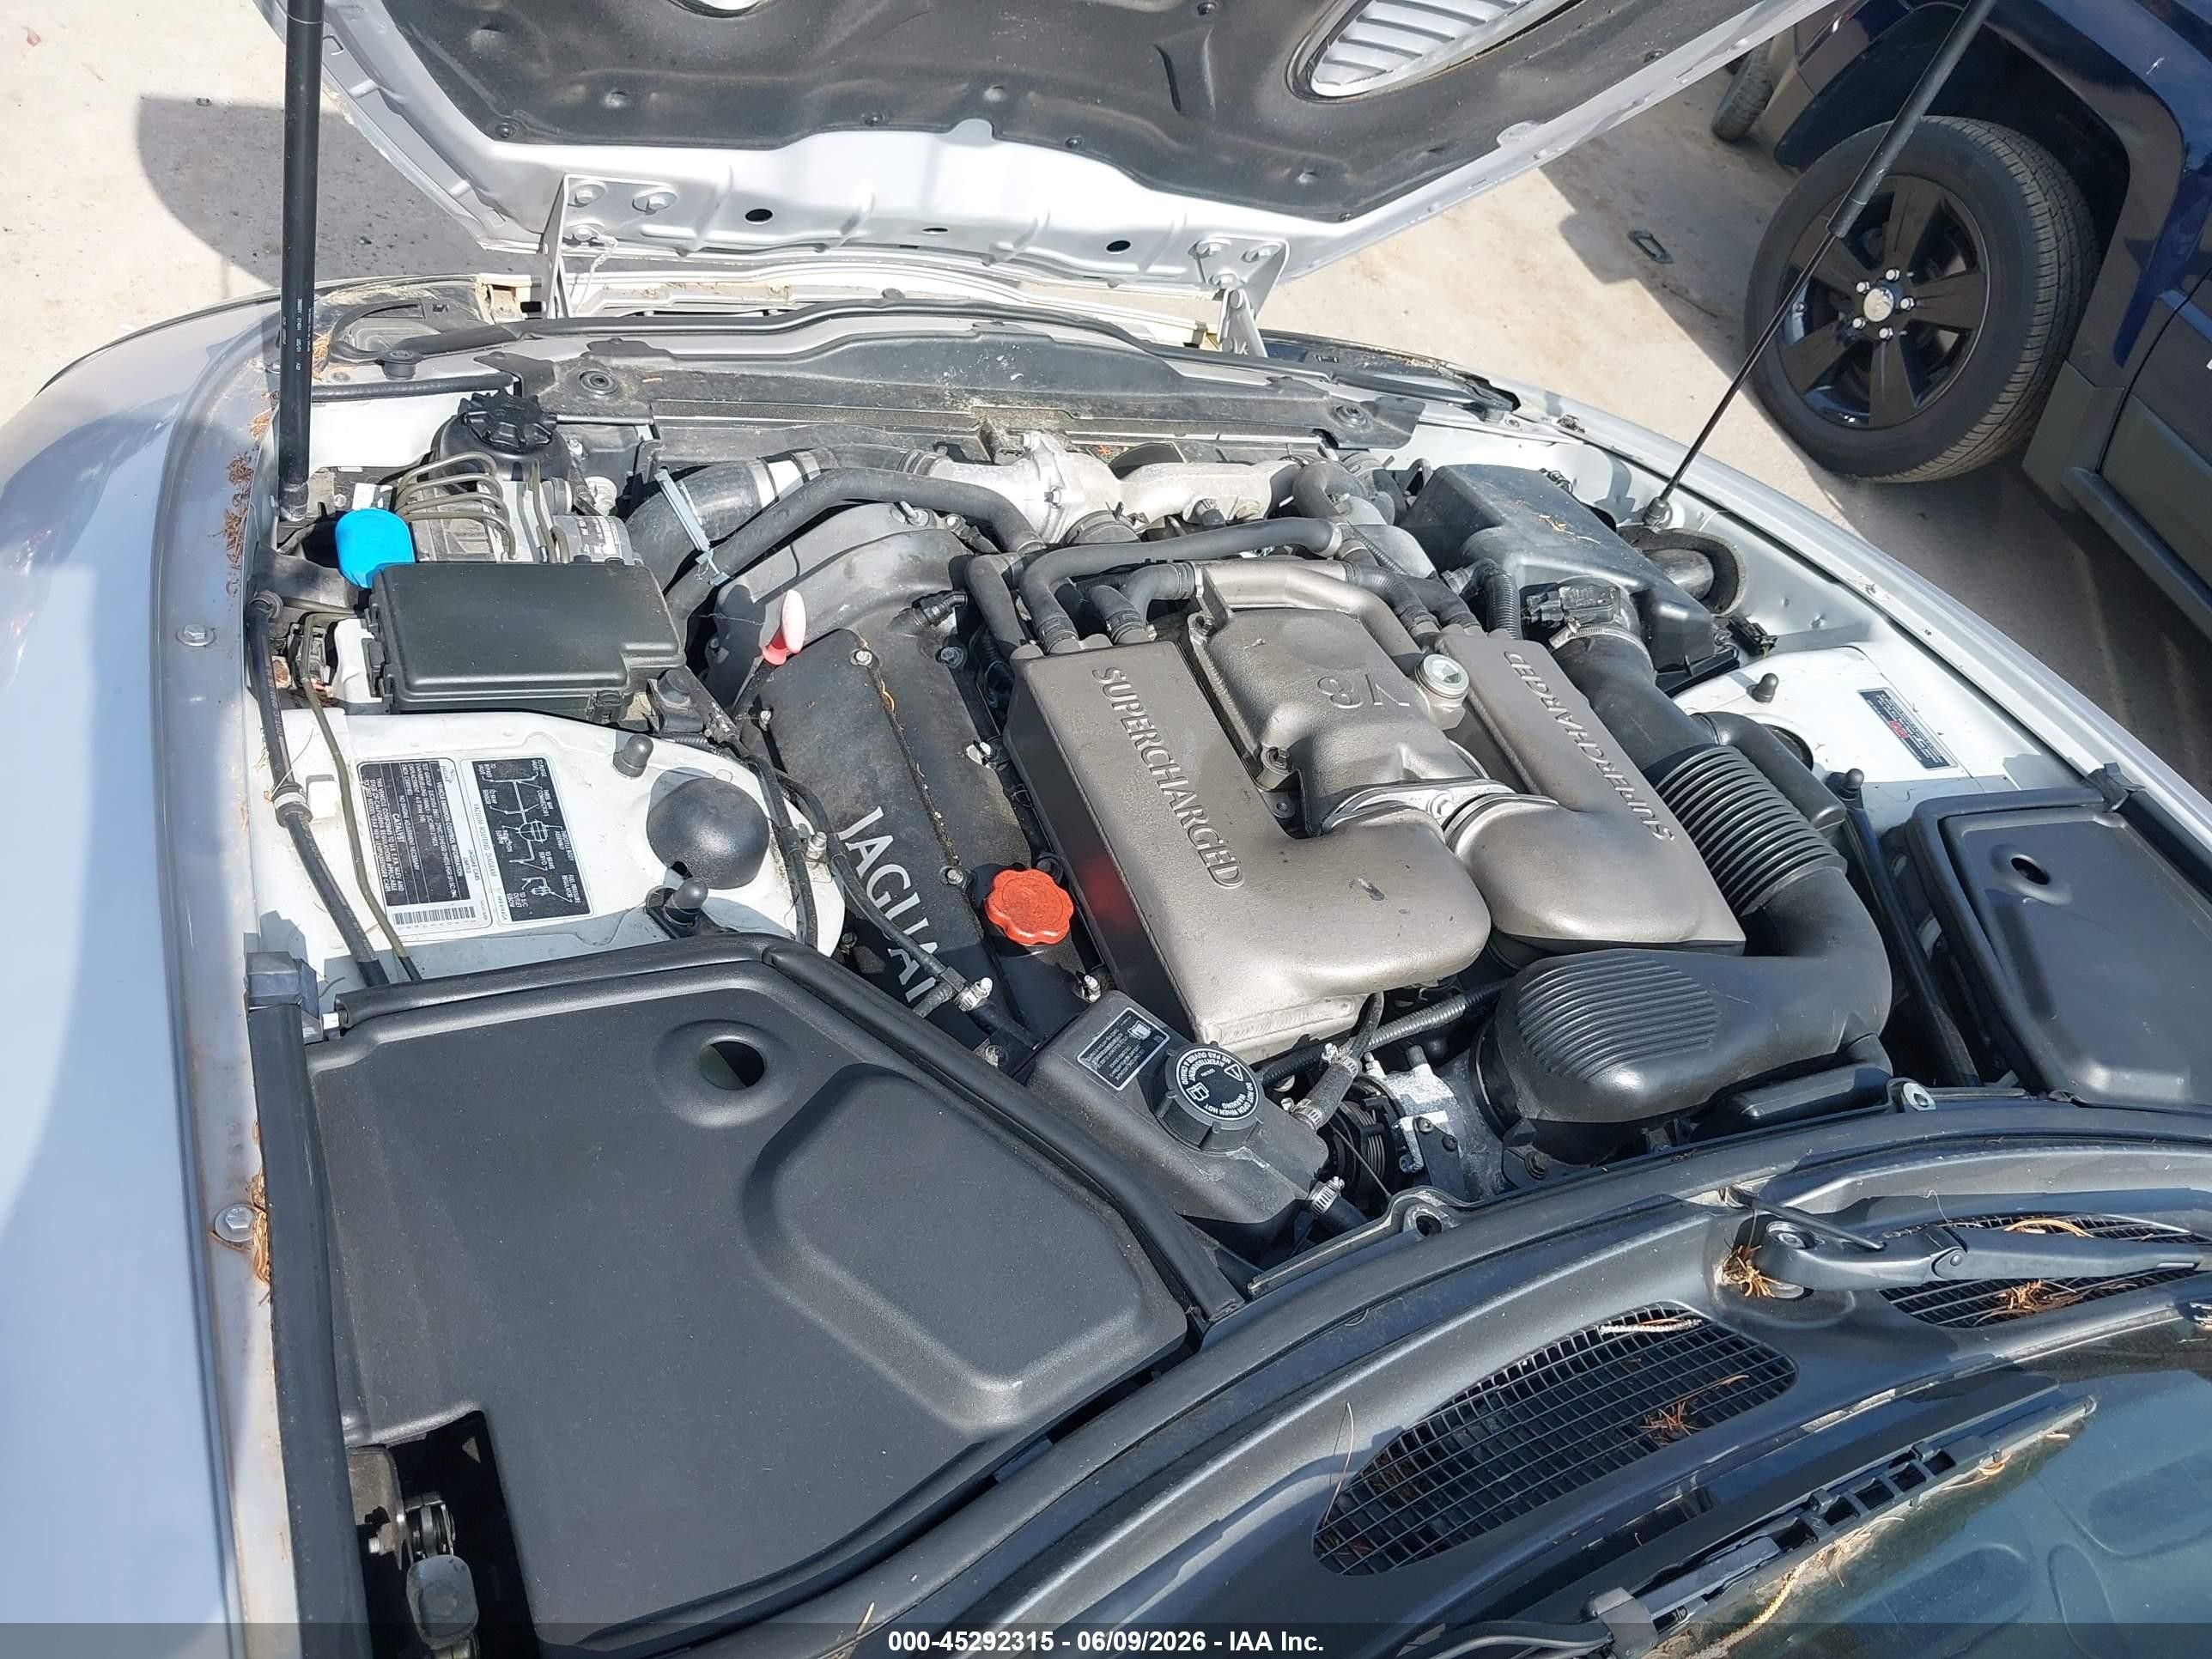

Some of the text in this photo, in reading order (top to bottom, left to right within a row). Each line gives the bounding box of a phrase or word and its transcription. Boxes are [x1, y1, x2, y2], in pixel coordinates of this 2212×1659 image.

[1316, 673, 1411, 709] V8
[1504, 651, 1675, 842] SUPERCHARGED
[408, 763, 419, 793] DISPLACEMENT
[1092, 666, 1244, 890] SUPERCHARGED
[378, 787, 386, 806] VEHICLE
[537, 789, 550, 816] CONNECTORS
[381, 807, 392, 835] CONFORMS
[392, 813, 404, 842] CATALYST
[374, 800, 385, 828] CALIFORNIA
[380, 830, 392, 861] REGULATIONS
[386, 862, 397, 891] APPLICABLE
[404, 819, 414, 845] ADJUSTMENT
[409, 846, 419, 870] NECESSARY
[441, 799, 451, 821] EMISSION
[450, 844, 463, 876] INFORMATION
[473, 803, 483, 824] VACUUM
[485, 852, 497, 877] DIAGRAM
[562, 874, 573, 898] REGULATOR
[1186, 1052, 1206, 1064] OUVRIR
[1188, 1059, 1224, 1081] AVERTISSEMENT
[1246, 1082, 1254, 1091] DO
[1204, 1103, 1218, 1114] HOT
[1222, 1093, 1246, 1109] WARNING
[1237, 1102, 1250, 1115] OPEN
